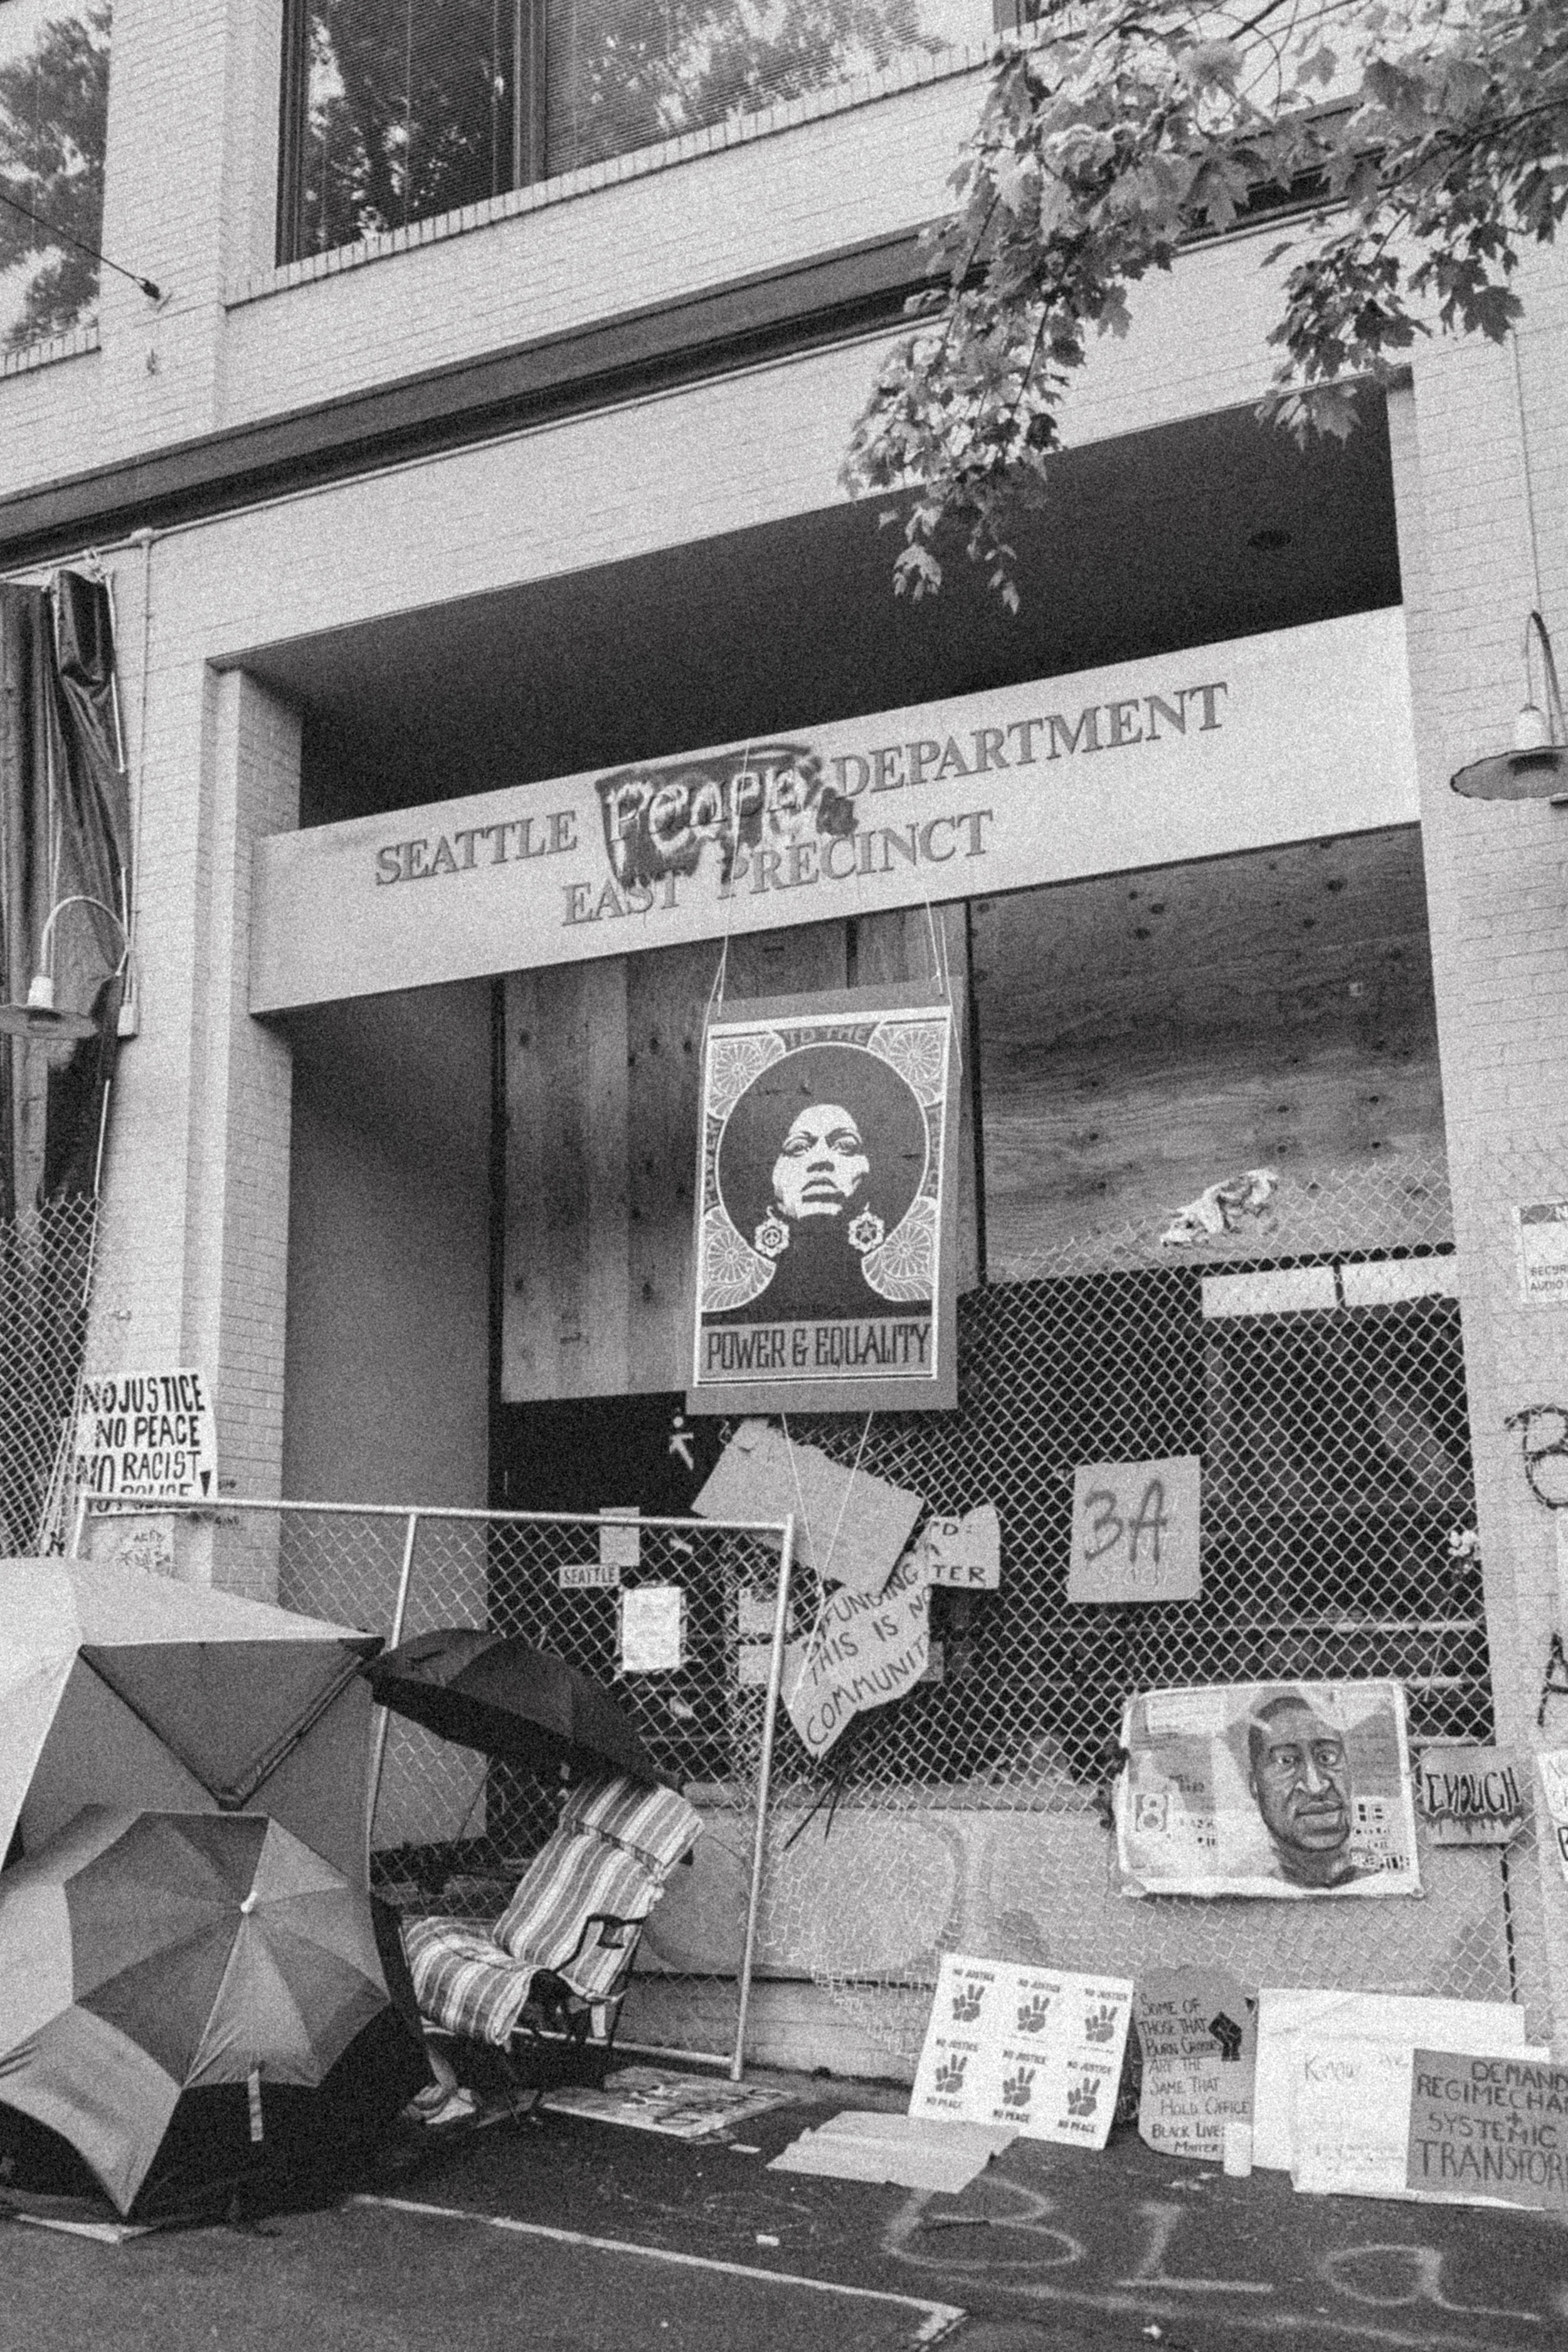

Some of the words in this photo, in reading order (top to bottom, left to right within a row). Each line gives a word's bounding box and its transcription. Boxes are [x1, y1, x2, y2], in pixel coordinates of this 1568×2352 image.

[376, 810, 577, 886] SEATTLE
[830, 682, 1228, 800] DEPARTMENT
[562, 869, 679, 926] EAST
[716, 810, 993, 900] PRECINCT
[786, 1027, 815, 1046] TO
[825, 1024, 869, 1044] THE
[707, 1328, 785, 1370] POWER
[815, 1323, 931, 1368] EQUALITY
[80, 1381, 117, 1414] NO
[119, 1374, 205, 1414] JUSTICE
[95, 1417, 126, 1448] NO
[134, 1414, 200, 1448] PEACE
[122, 1450, 201, 1481] RACIST
[1084, 1478, 1169, 1563] 3A
[564, 1567, 617, 1584] SEATTLE
[872, 1614, 899, 1643] IS
[1140, 1993, 1177, 2016] SOME
[1182, 1998, 1199, 2014] OF
[1177, 2018, 1207, 2034] THAT
[1150, 2076, 1185, 2095] SAME
[1187, 2075, 1219, 2092] THAT
[1160, 2099, 1198, 2116] HOLD
[1509, 2089, 1568, 2114] CHA
[1428, 2111, 1557, 2149] SYSTEMIC
[1414, 2139, 1568, 2191] TRANSFOR
